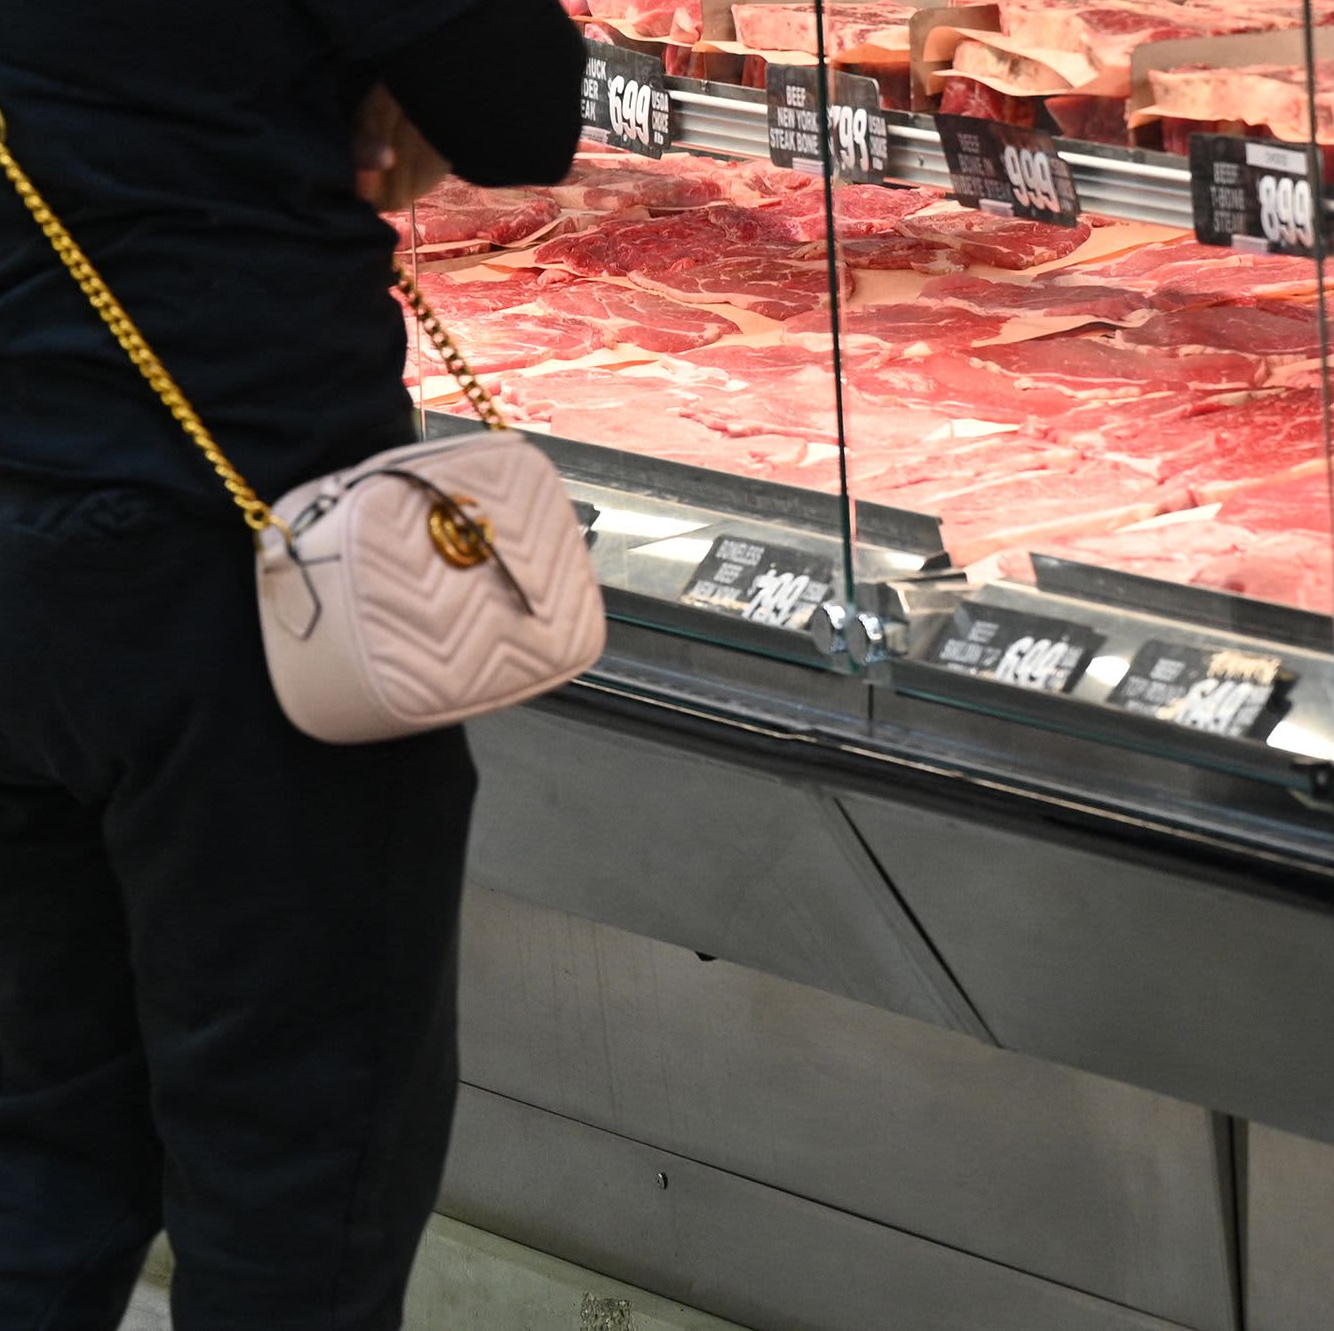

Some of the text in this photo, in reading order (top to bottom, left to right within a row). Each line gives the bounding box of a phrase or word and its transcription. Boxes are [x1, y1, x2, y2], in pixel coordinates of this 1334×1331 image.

[585, 57, 607, 81] HUCK
[785, 85, 806, 107] BEEF
[777, 107, 819, 133] NEW YORK
[770, 127, 819, 155] STEAK BONE
